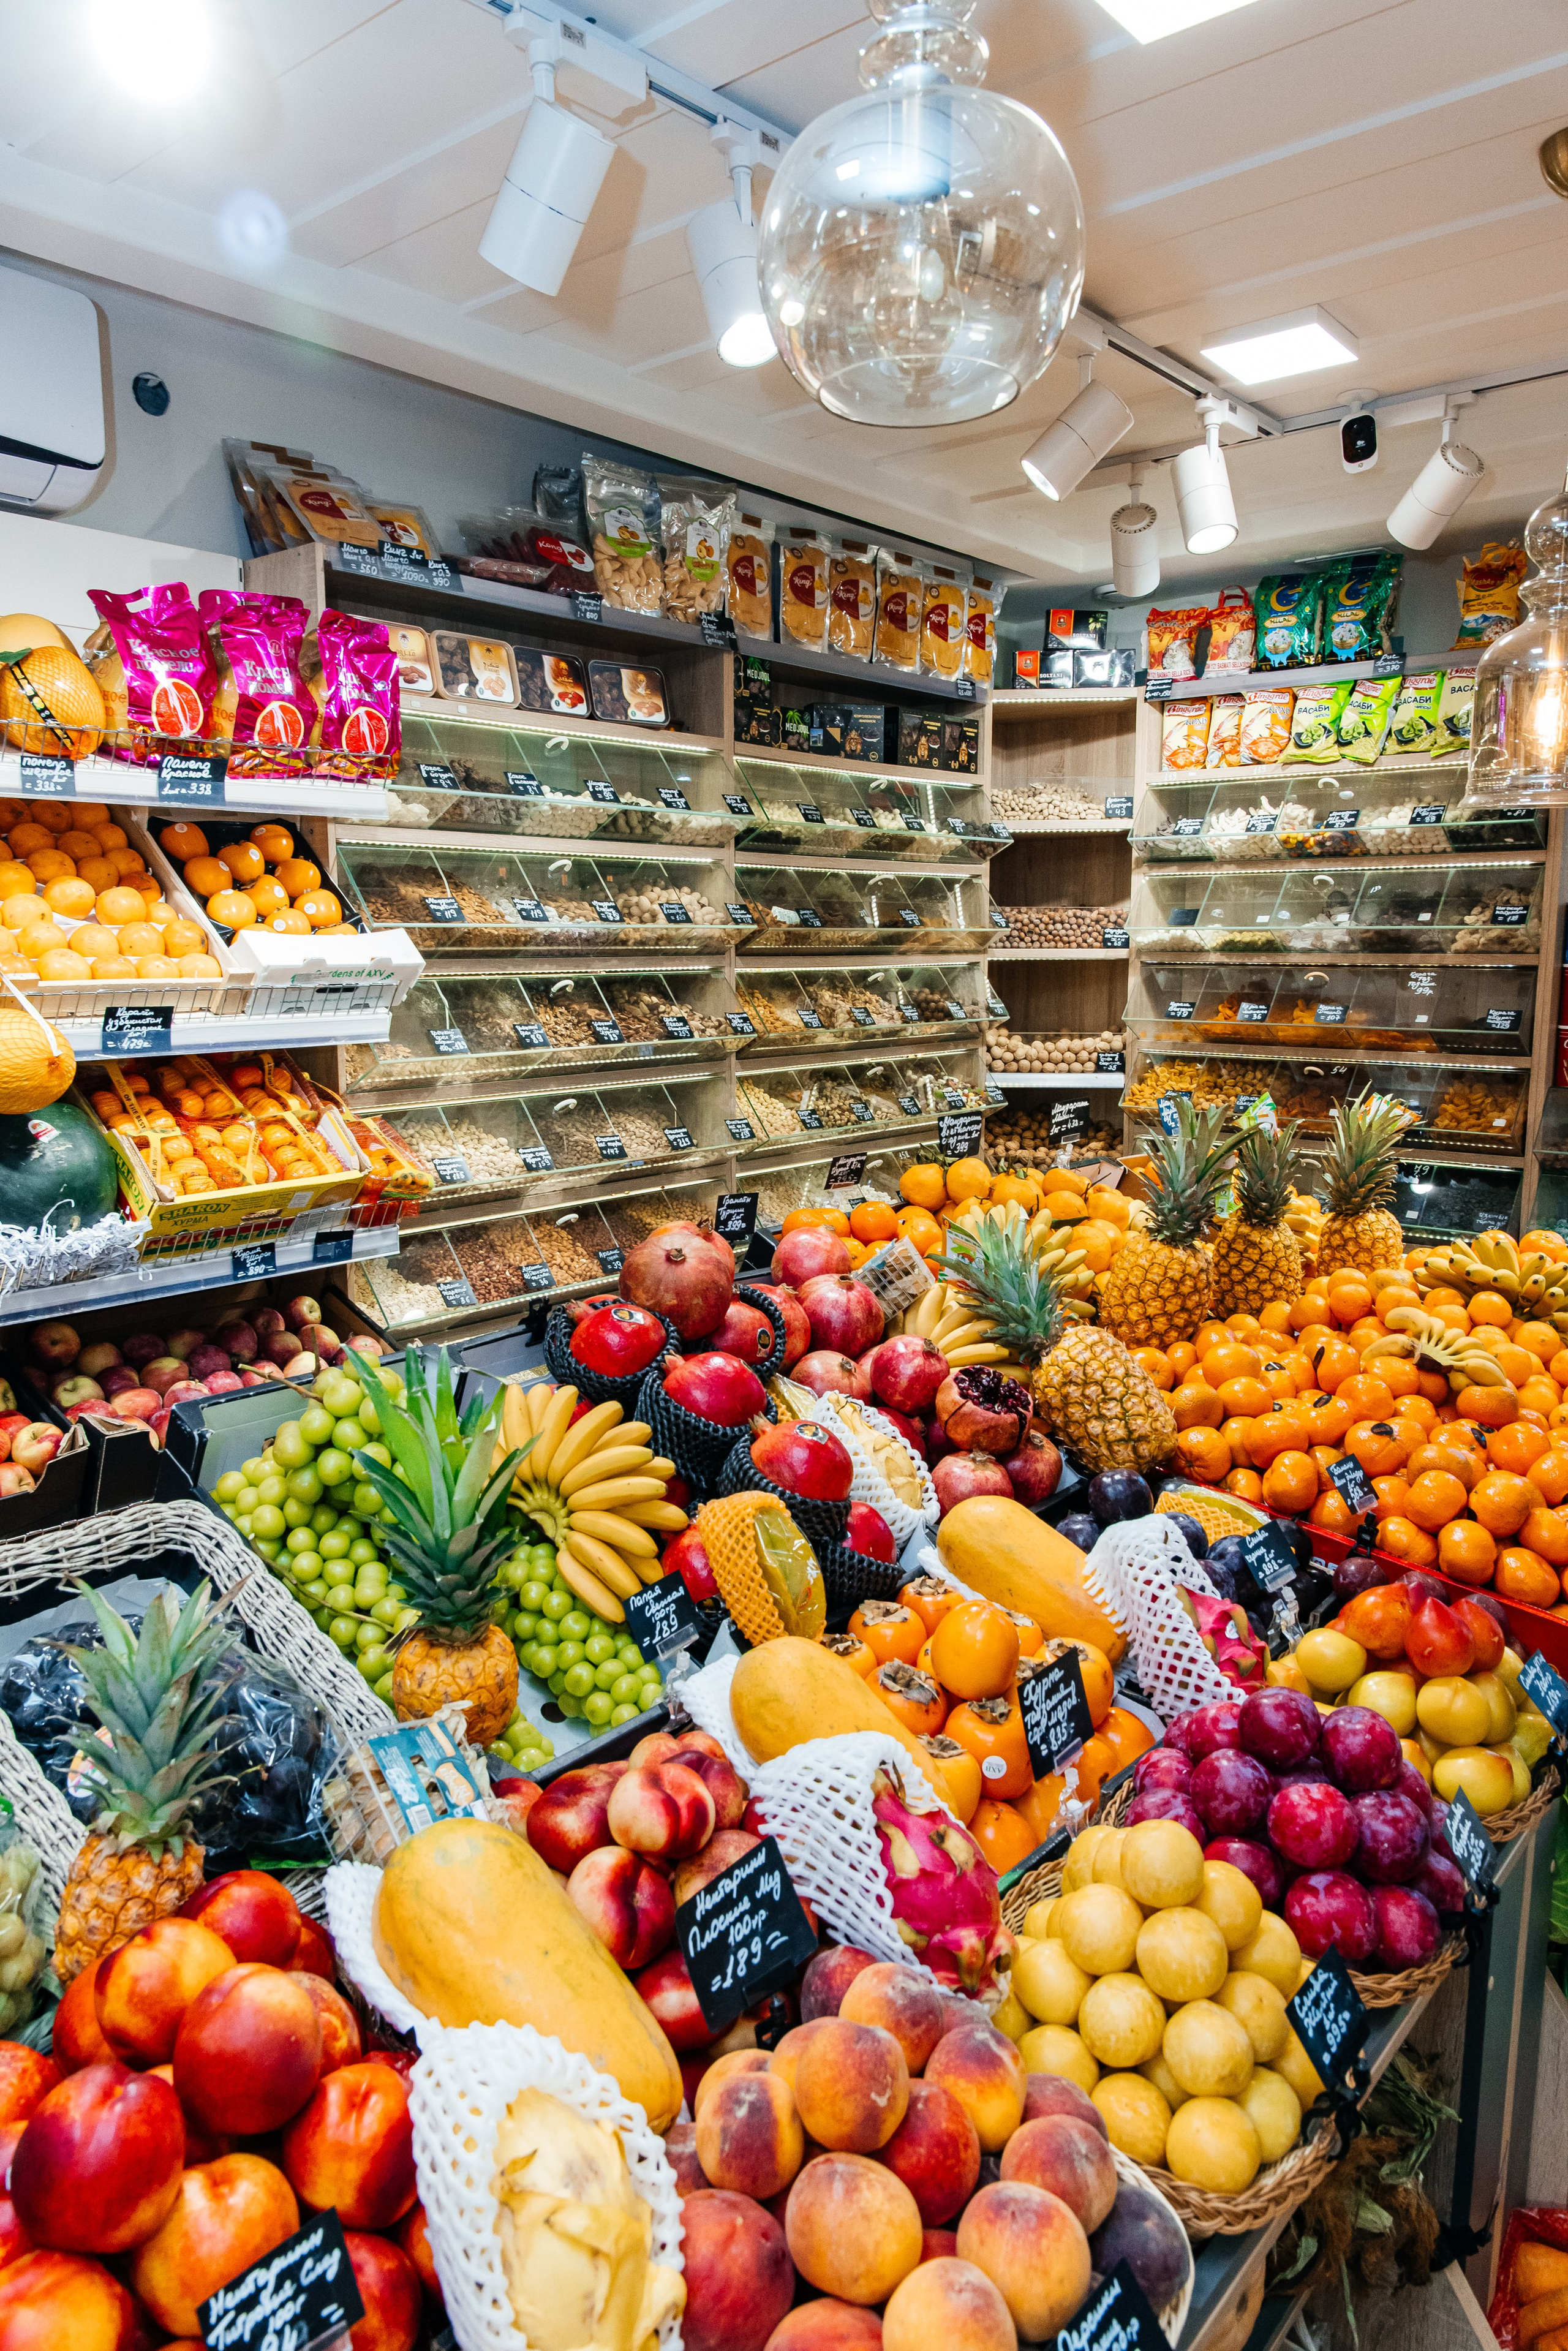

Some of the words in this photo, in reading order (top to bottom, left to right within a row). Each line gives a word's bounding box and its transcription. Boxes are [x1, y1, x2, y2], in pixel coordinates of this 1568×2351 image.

[538, 540, 562, 552] Kong
[747, 669, 771, 682] MEDJOOL
[1248, 692, 1289, 703] Binggrae
[1298, 688, 1336, 699] Binggrae
[1167, 705, 1205, 715] Binggrae
[1298, 705, 1330, 715] ВАСАБИ
[785, 723, 810, 734] MEDJOOL
[440, 779, 453, 788] 84
[527, 785, 539, 794] 84
[445, 910, 457, 919] 119
[530, 909, 543, 918] 119
[356, 968, 366, 978] of
[530, 1034, 544, 1044] 89
[1330, 1066, 1347, 1074] 54
[134, 1111, 146, 1130] BEST
[954, 1142, 968, 1153] 399
[538, 1160, 551, 1168] 159
[116, 1150, 144, 1211] HARON
[160, 1204, 230, 1220] SHARON
[171, 1216, 209, 1227] ХУРМА
[630, 1585, 662, 1612] Папая
[696, 1847, 766, 1922] Нектарины
